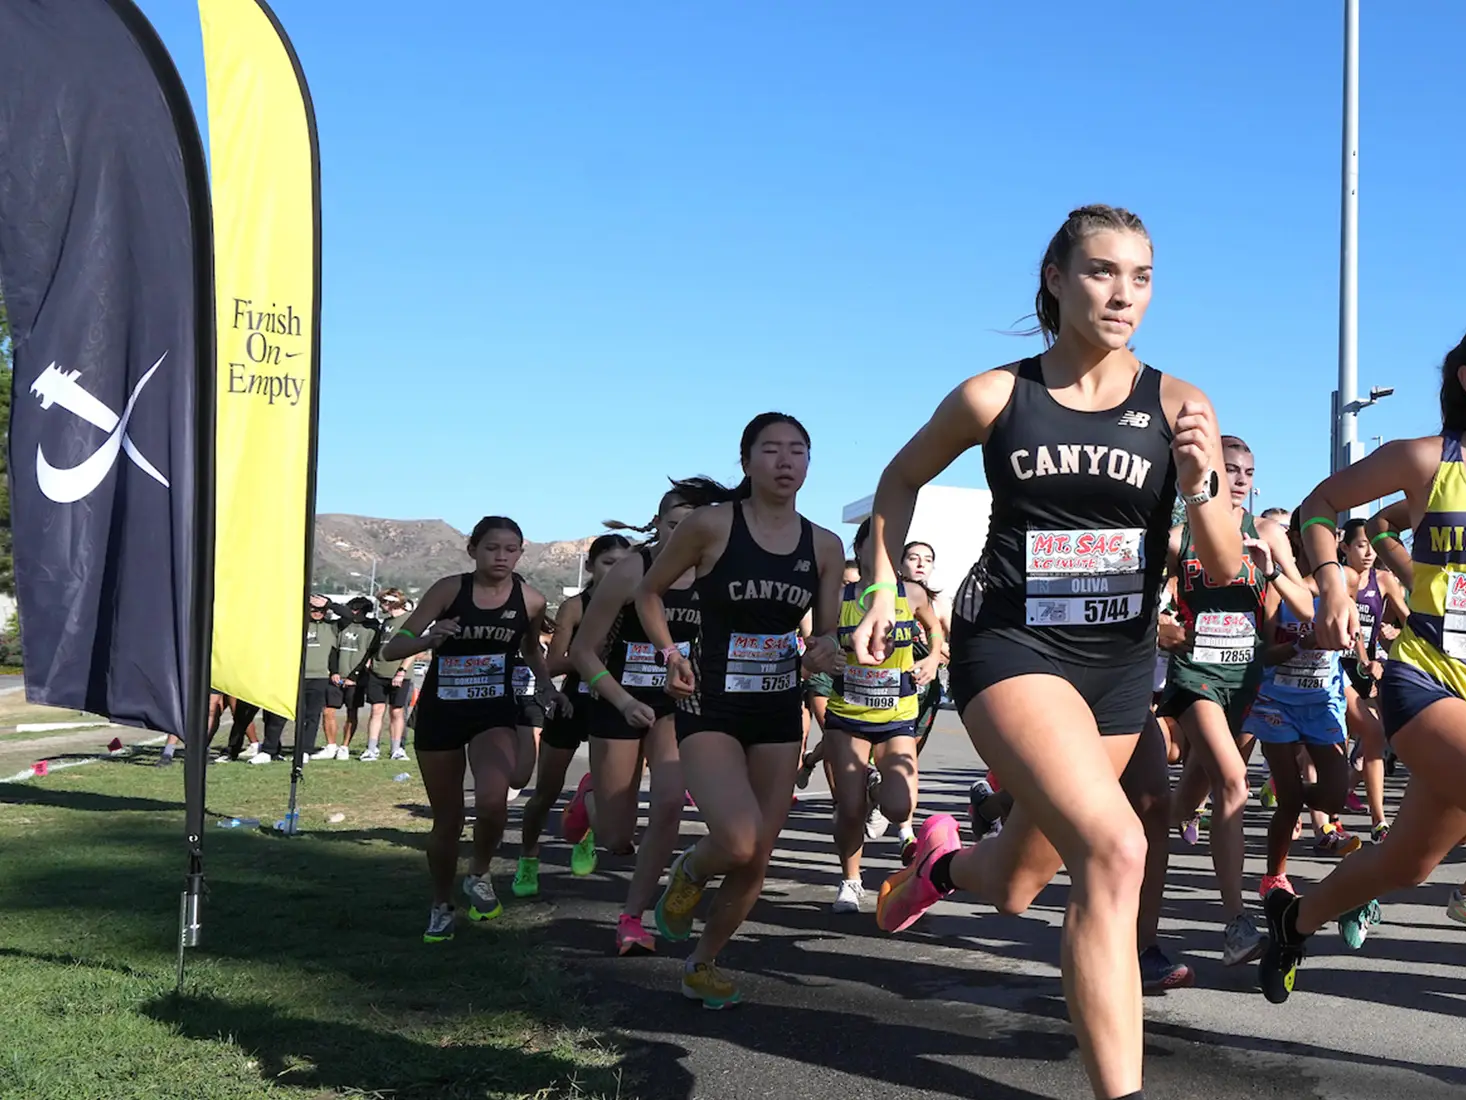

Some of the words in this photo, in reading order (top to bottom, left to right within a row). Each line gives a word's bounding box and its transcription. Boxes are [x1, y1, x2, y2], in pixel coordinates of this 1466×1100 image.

[233, 297, 302, 336] Finish
[246, 332, 281, 365] On
[227, 363, 305, 406] Empty
[1010, 444, 1152, 489] CANYON
[1033, 534, 1071, 555] MT.
[1075, 534, 1123, 555] SAC
[1032, 558, 1053, 569] XC
[1056, 558, 1096, 569] INVITE
[1071, 577, 1108, 593] OLIVA
[728, 580, 812, 610] CANYON
[664, 607, 701, 625] NYON
[1084, 597, 1129, 623] 5744
[1223, 615, 1246, 626] SAC
[1220, 649, 1251, 663] 12855
[651, 675, 665, 686] 57
[467, 686, 496, 698] 5736
[864, 697, 895, 707] 11098
